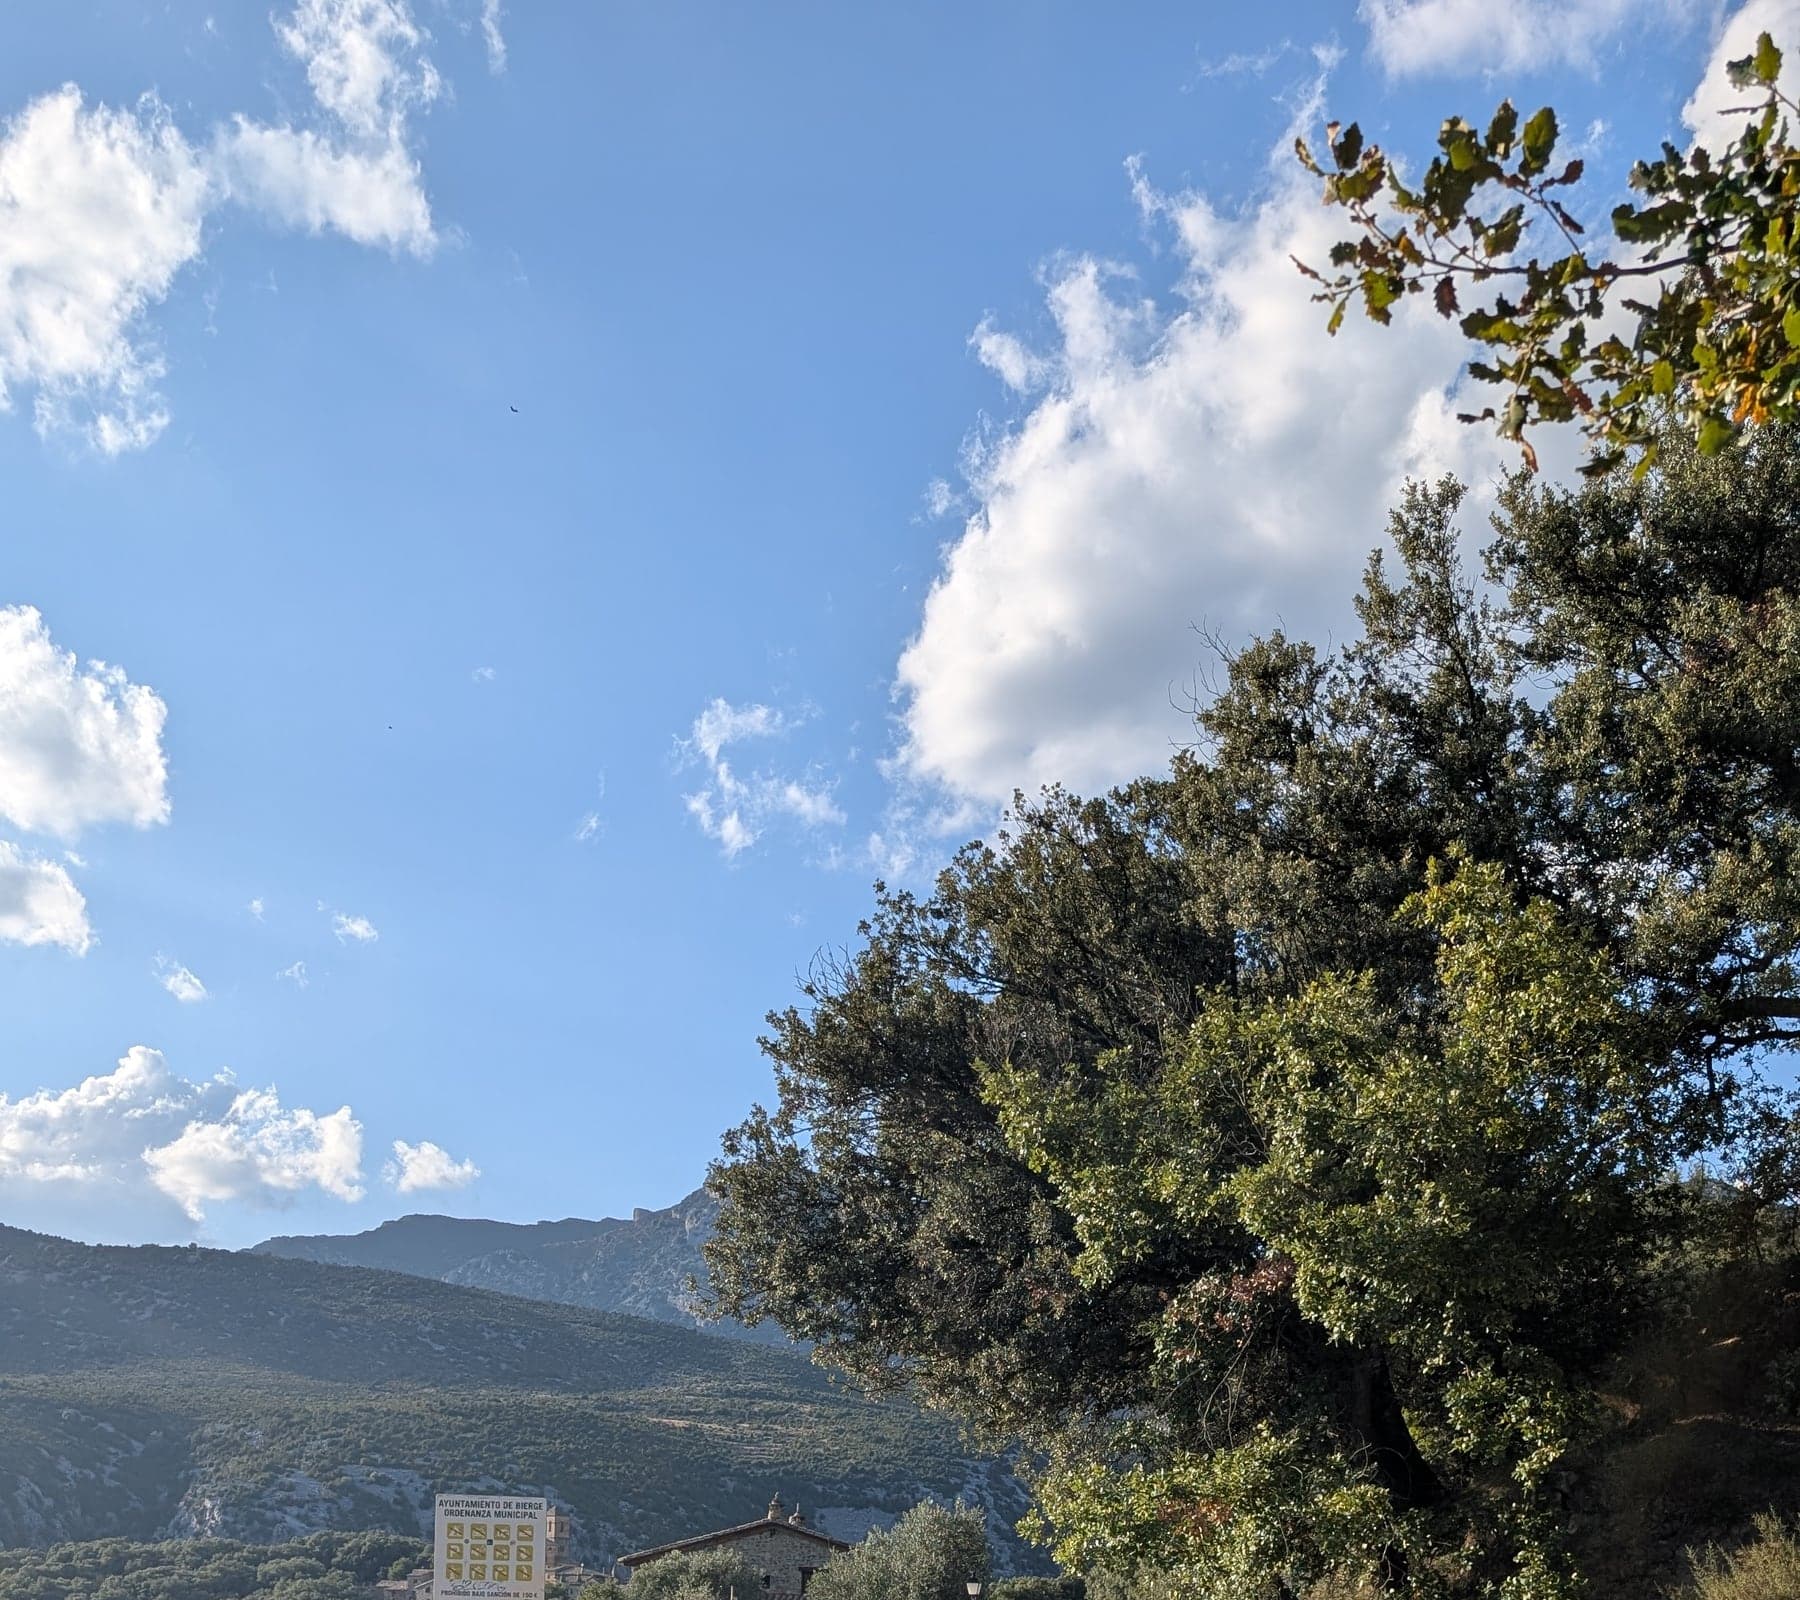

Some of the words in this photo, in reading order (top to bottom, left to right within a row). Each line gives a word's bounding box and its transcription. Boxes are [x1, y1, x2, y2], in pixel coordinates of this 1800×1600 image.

[438, 1499, 501, 1509] AYUNTAMIENTO
[503, 1501, 514, 1509] DE
[515, 1502, 544, 1511] BIERGE
[444, 1508, 492, 1518] ORDENANZA
[493, 1510, 538, 1520] MUNICIPAL
